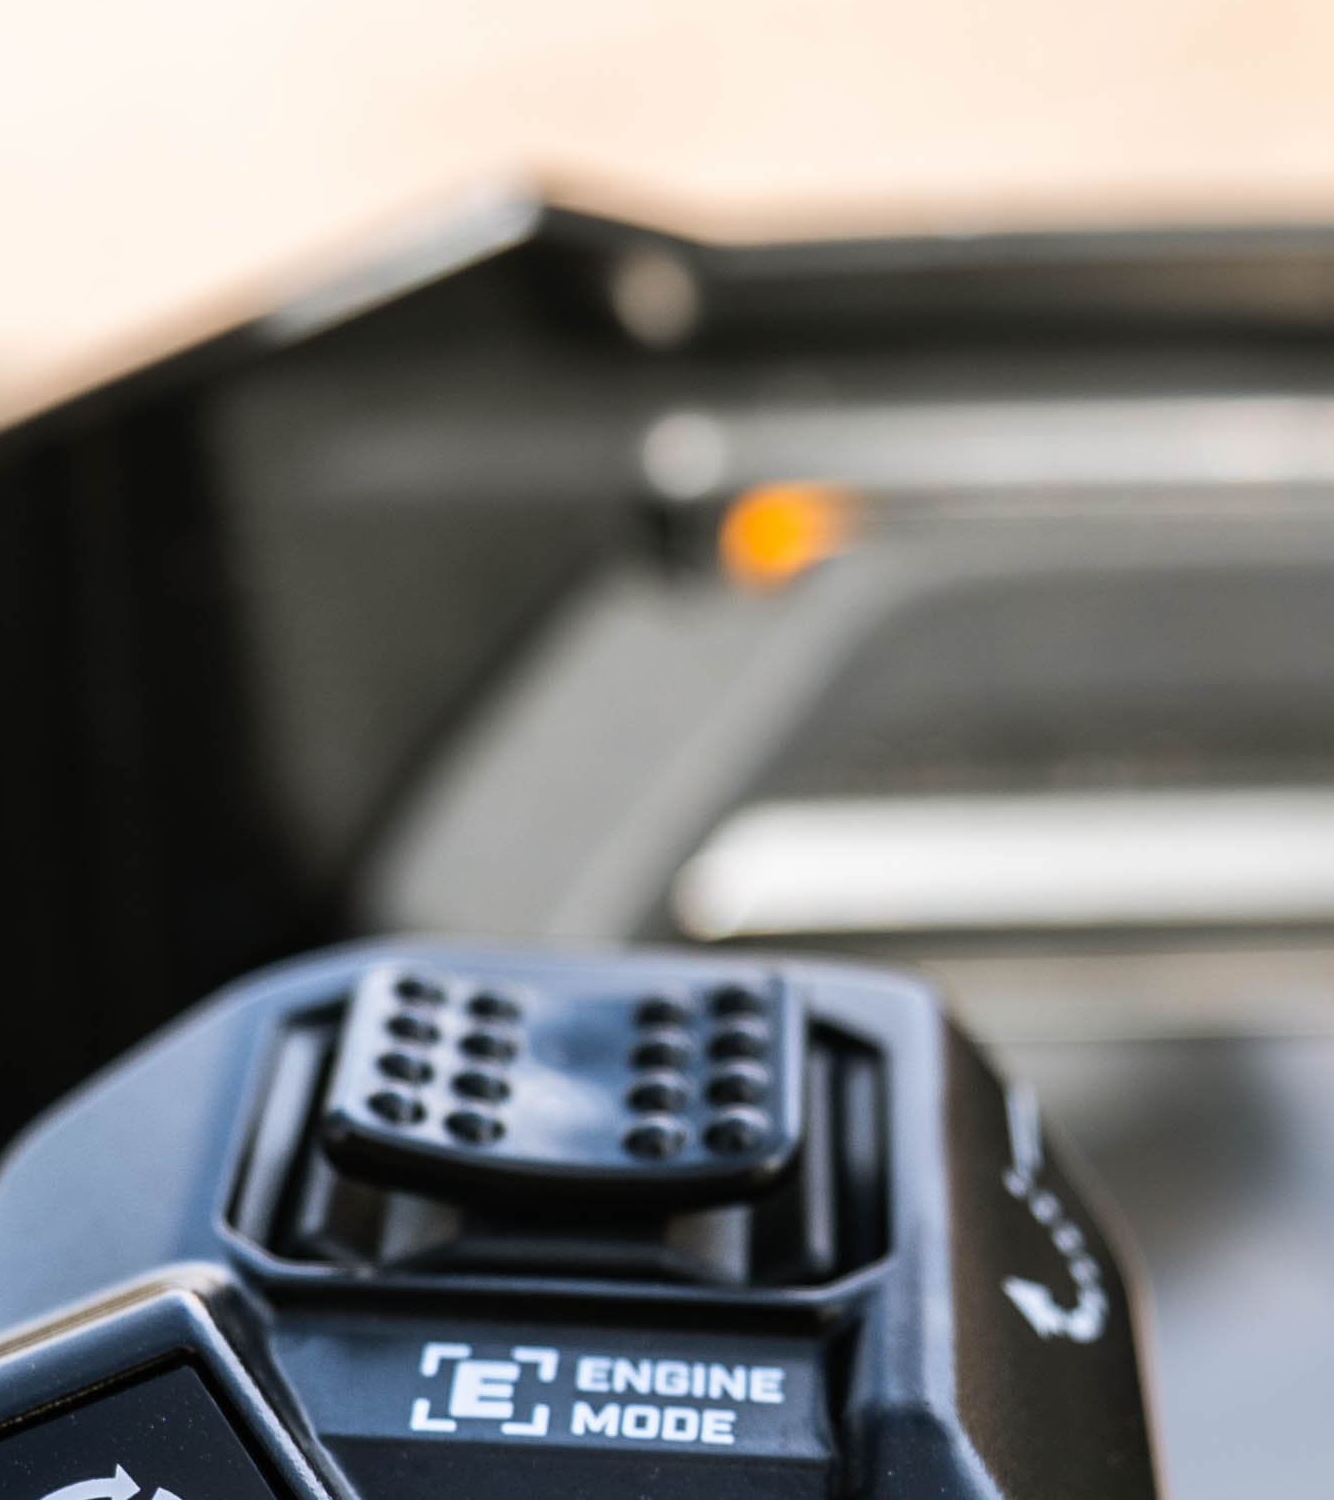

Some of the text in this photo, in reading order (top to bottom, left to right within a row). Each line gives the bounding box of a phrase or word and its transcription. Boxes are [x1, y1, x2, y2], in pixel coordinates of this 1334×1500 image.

[448, 1360, 522, 1419] E
[575, 1356, 785, 1403] ENGINE
[570, 1401, 737, 1445] MODE
